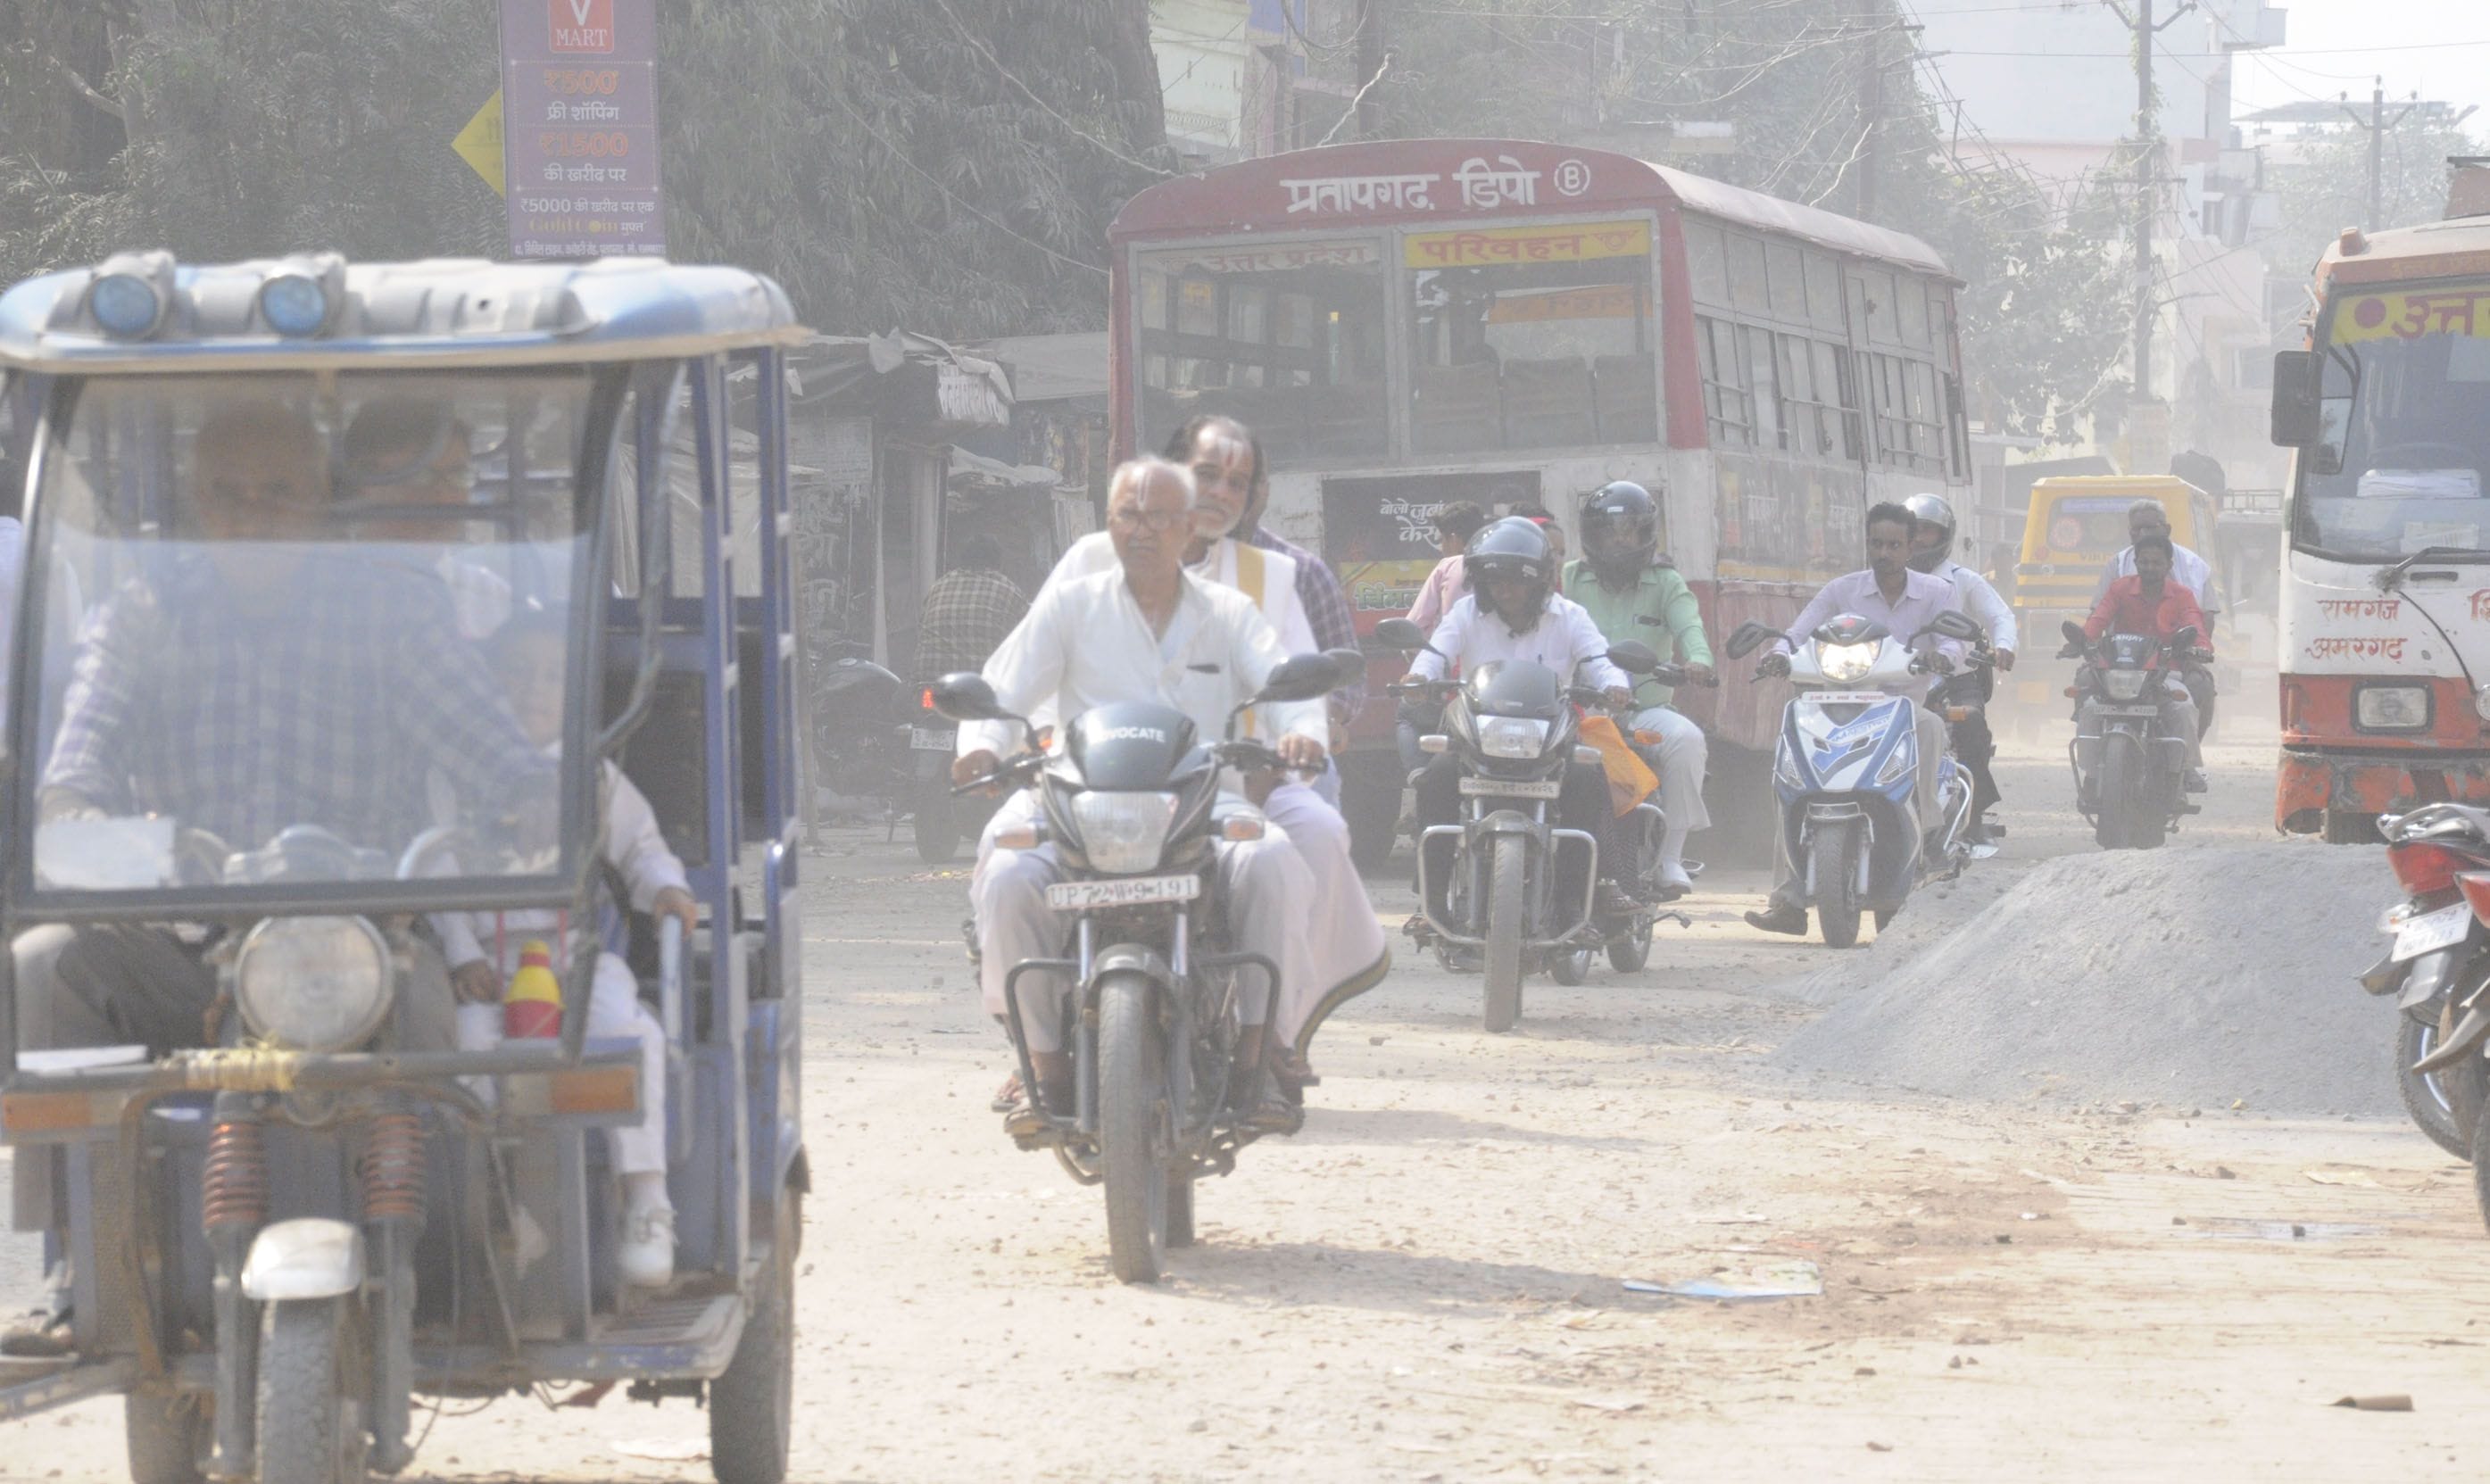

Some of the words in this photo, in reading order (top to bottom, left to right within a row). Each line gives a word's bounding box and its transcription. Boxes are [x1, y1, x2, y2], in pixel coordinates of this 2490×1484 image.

[571, 0, 591, 27] V
[555, 29, 608, 46] MART
[547, 101, 567, 120] फ्री
[571, 101, 620, 120] शॉपिंग
[540, 131, 629, 157] ₹1500
[544, 162, 565, 182] की
[567, 162, 606, 182] खरीद
[608, 168, 627, 182] पर
[1452, 154, 1542, 211] डिपो
[520, 197, 571, 212] ₹5000
[573, 197, 589, 211] की
[621, 201, 635, 212] पर
[1418, 234, 1585, 262] परिवहन
[2391, 292, 2490, 339] उत्त
[1380, 497, 1409, 515] बोलो
[1396, 515, 1442, 551] केस
[2318, 593, 2400, 621] रामगंज
